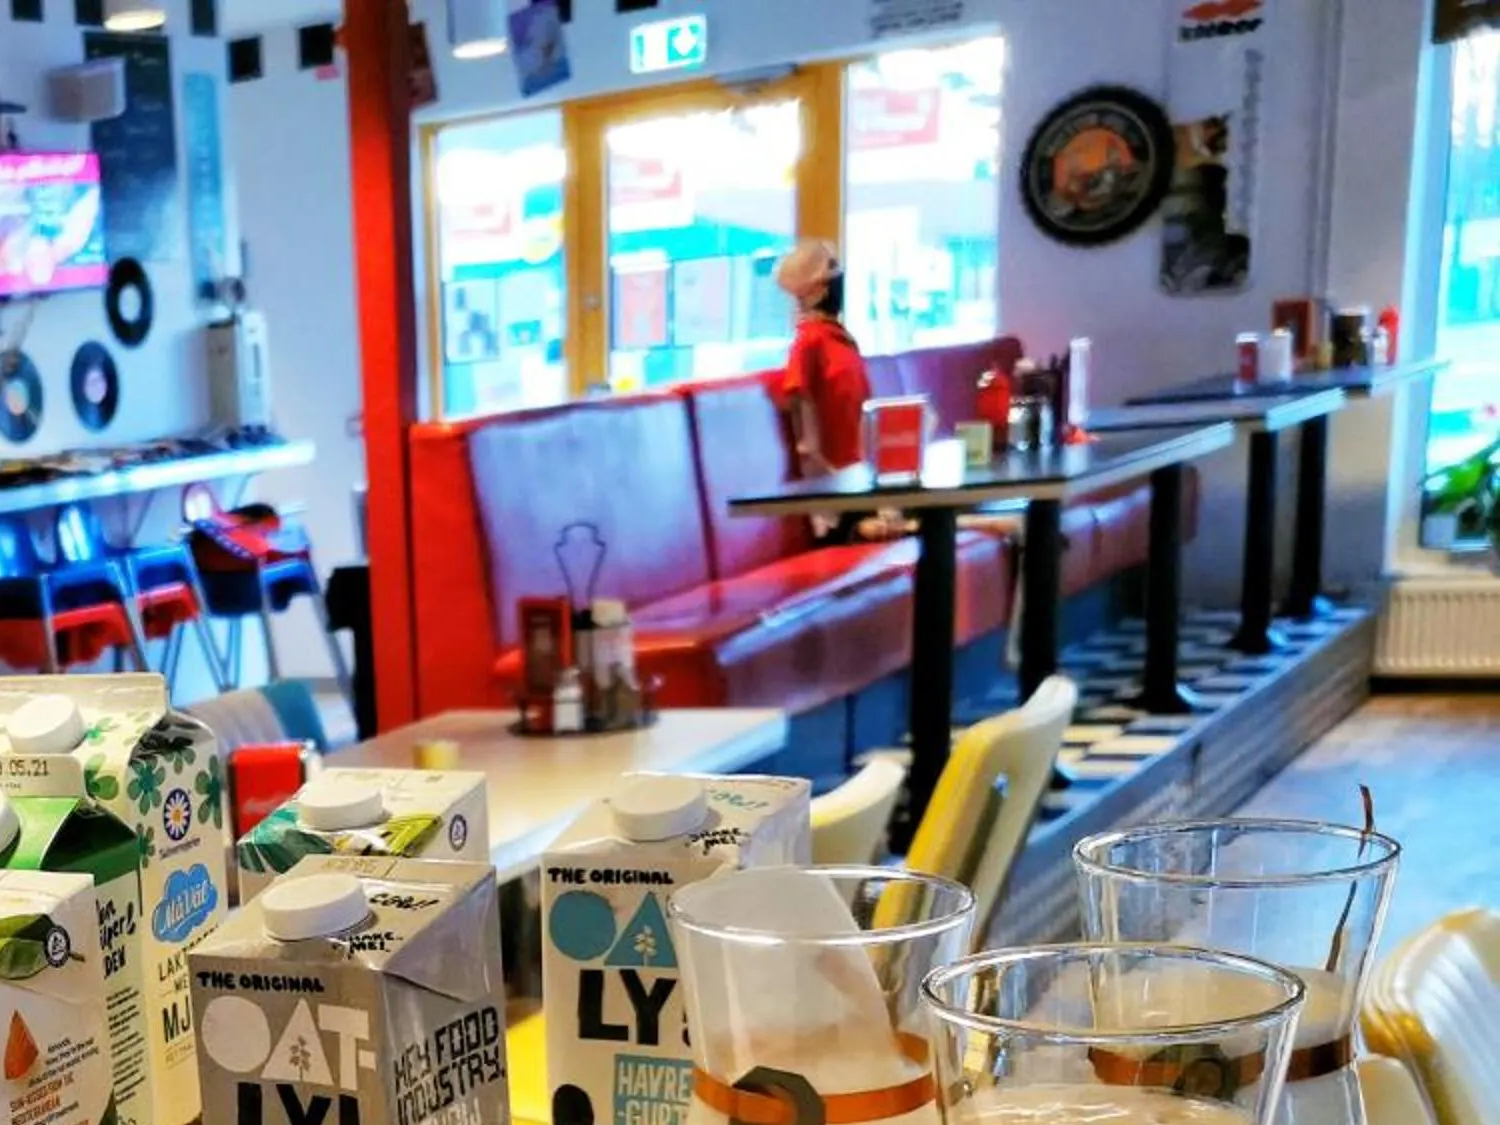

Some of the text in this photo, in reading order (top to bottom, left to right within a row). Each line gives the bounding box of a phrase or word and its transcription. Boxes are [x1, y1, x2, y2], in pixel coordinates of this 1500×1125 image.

[547, 867, 674, 885] THE ORIGINAL
[197, 972, 235, 990] THE
[239, 974, 324, 993] ORIGINAL
[393, 1006, 500, 1097] HEY FOOD
